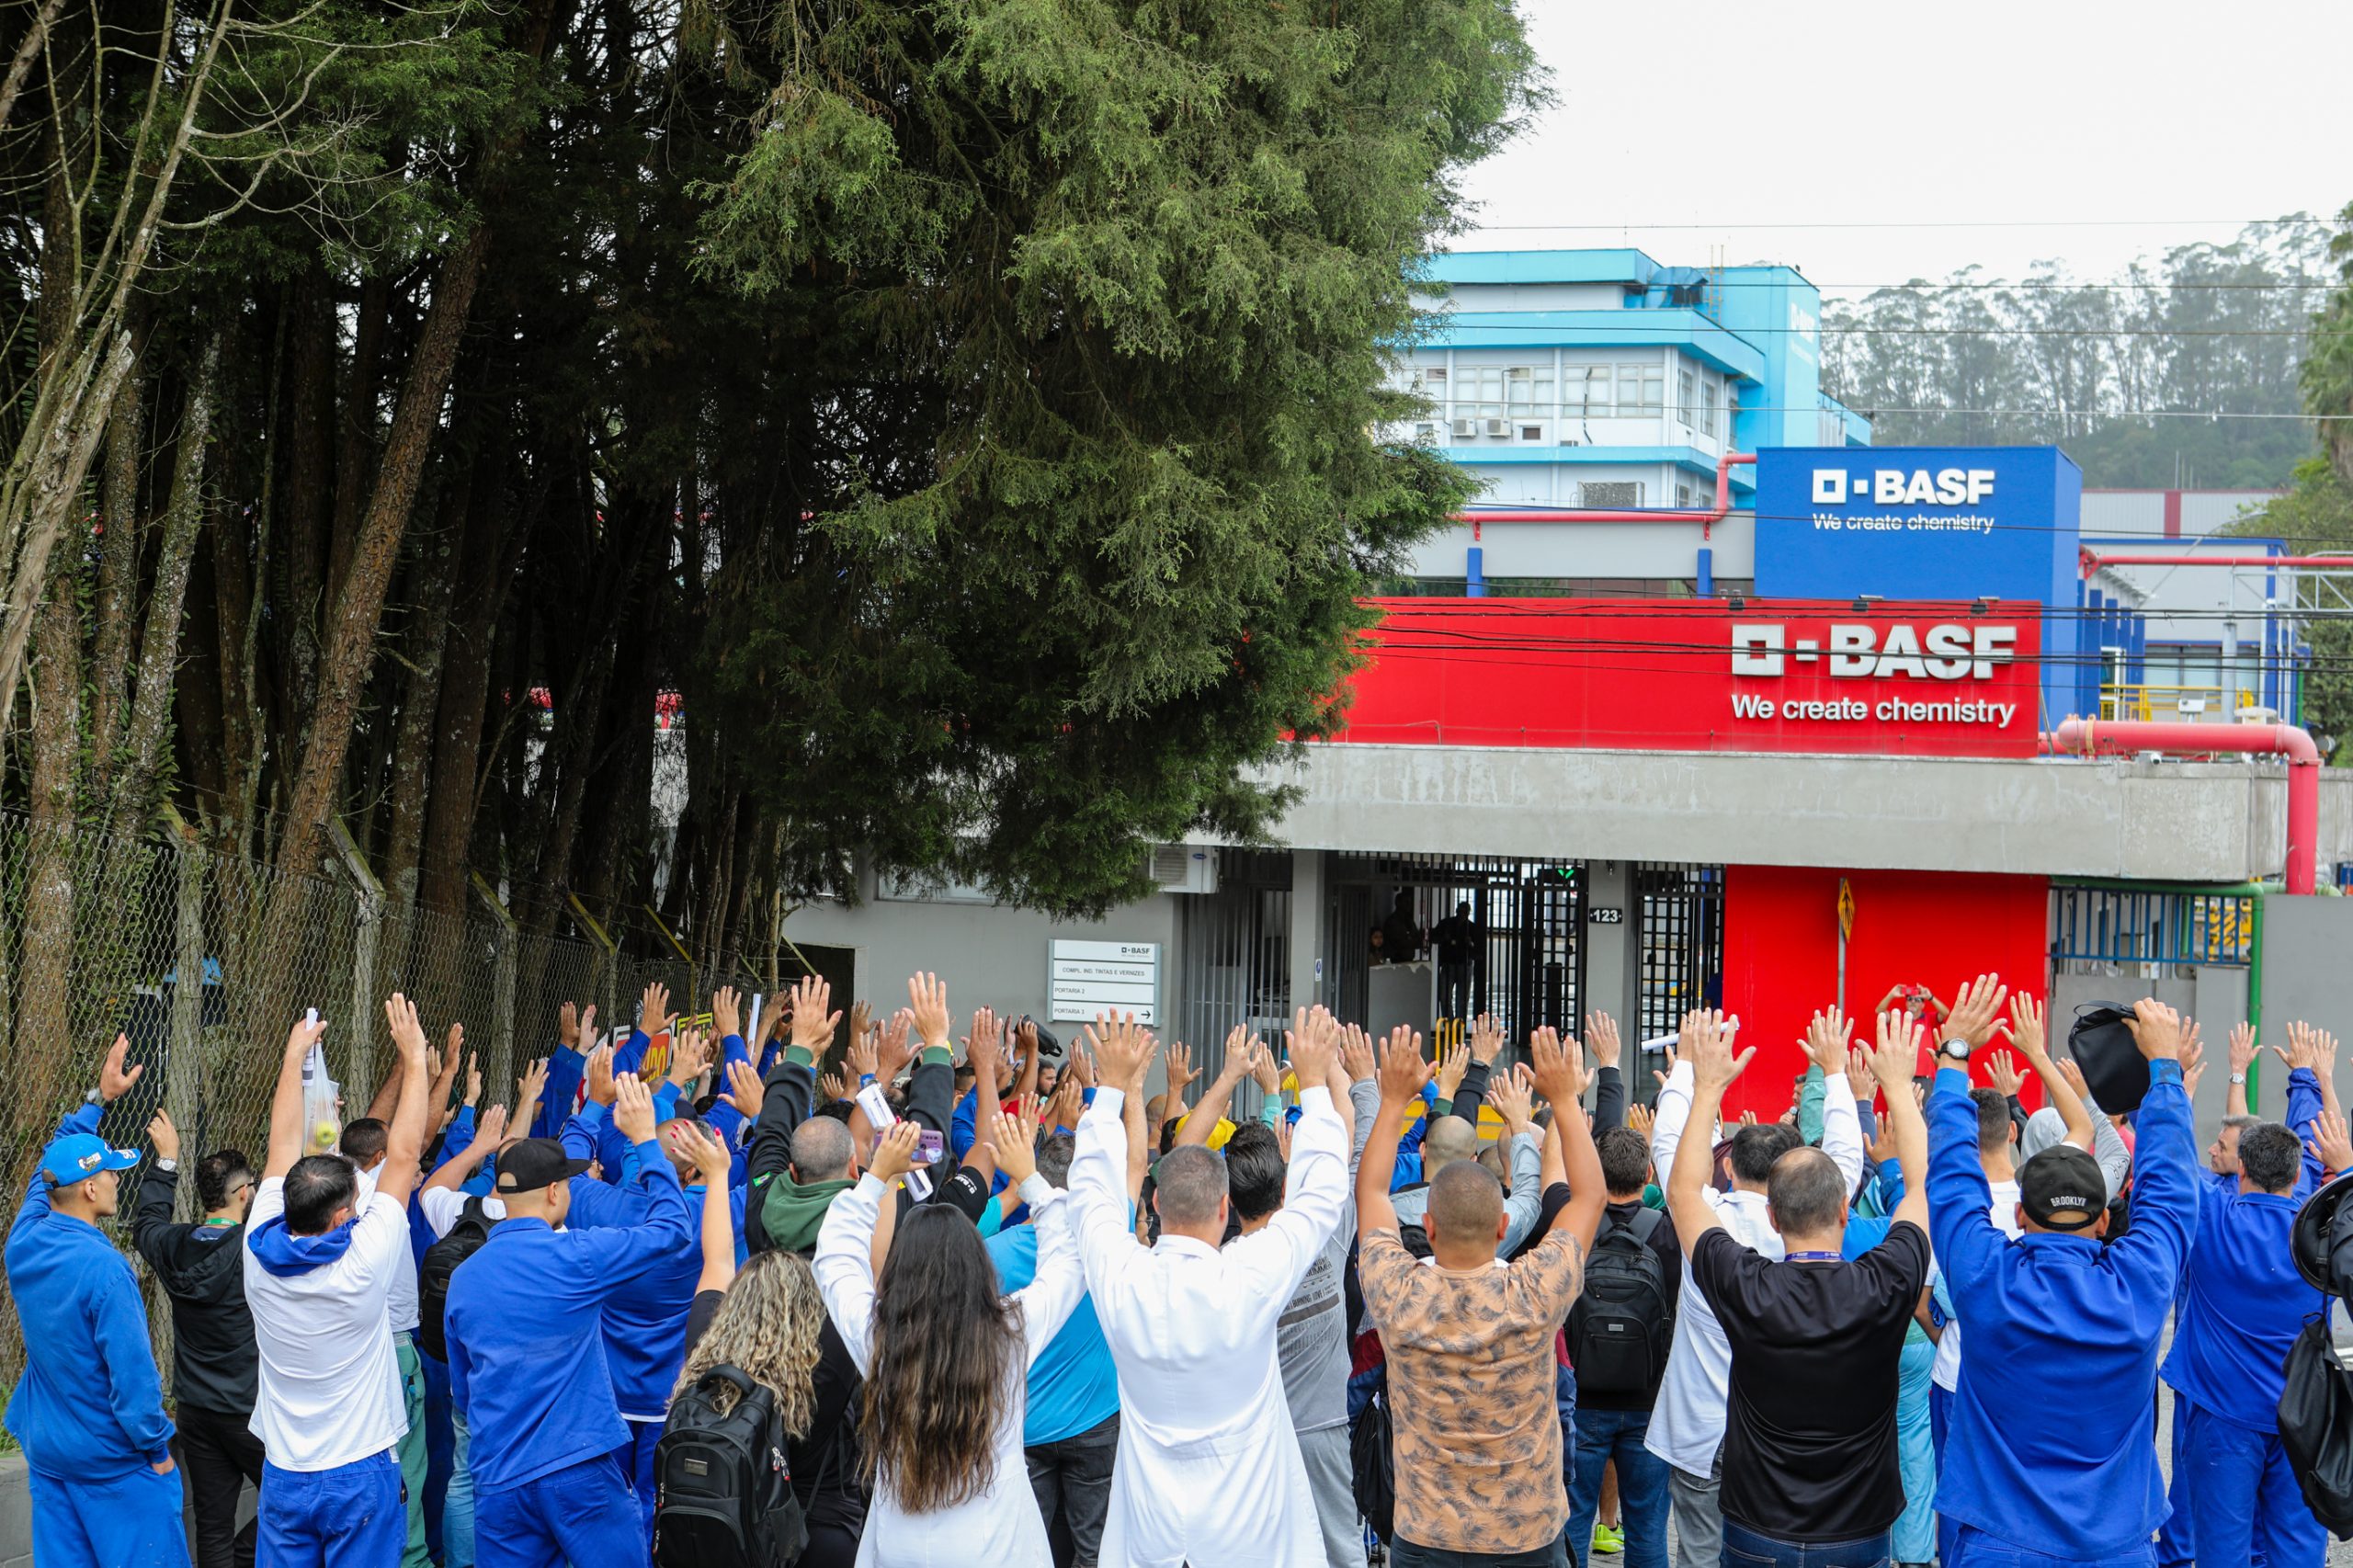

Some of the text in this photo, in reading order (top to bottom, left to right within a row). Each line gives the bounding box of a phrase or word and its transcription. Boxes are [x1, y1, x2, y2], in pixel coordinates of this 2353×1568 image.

[1874, 469, 1995, 506] BASF
[1812, 513, 1995, 535] We create chemistry
[1830, 624, 2018, 679] BASF
[1731, 694, 2017, 729] We create chemistry
[1593, 909, 1619, 923] 123
[2050, 1196, 2086, 1207] BROOKLYN
